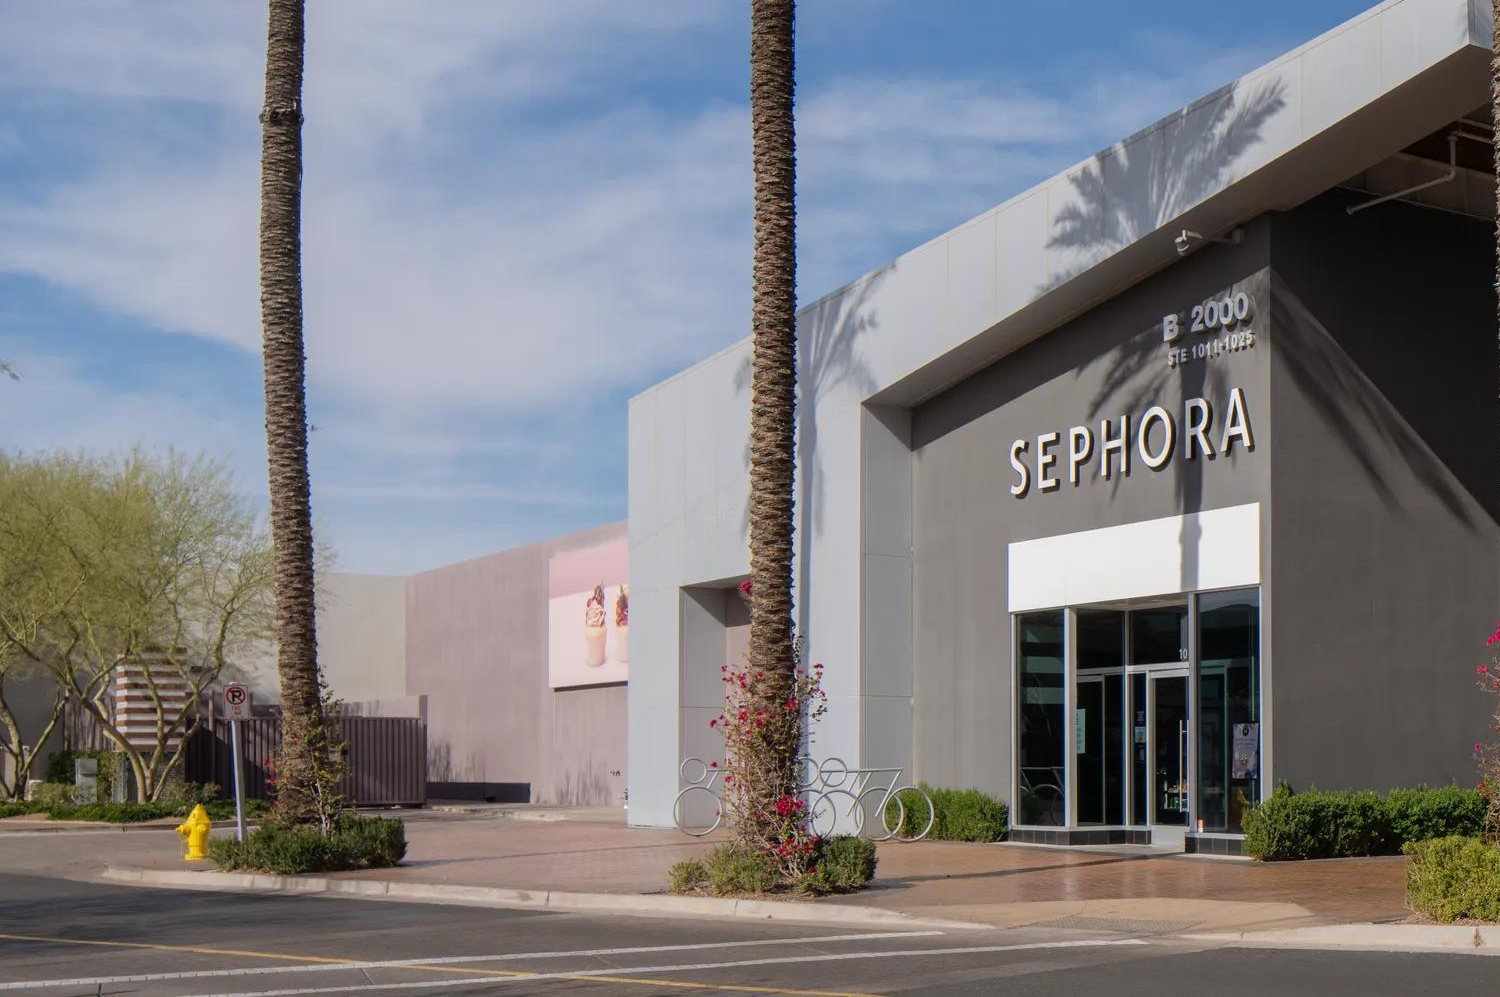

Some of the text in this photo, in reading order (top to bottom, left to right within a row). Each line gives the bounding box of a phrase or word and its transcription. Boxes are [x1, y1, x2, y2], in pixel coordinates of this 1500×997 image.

[1163, 292, 1250, 343] B 2000
[1167, 330, 1255, 367] STE 1011-1025
[1010, 387, 1256, 498] SEPHORA
